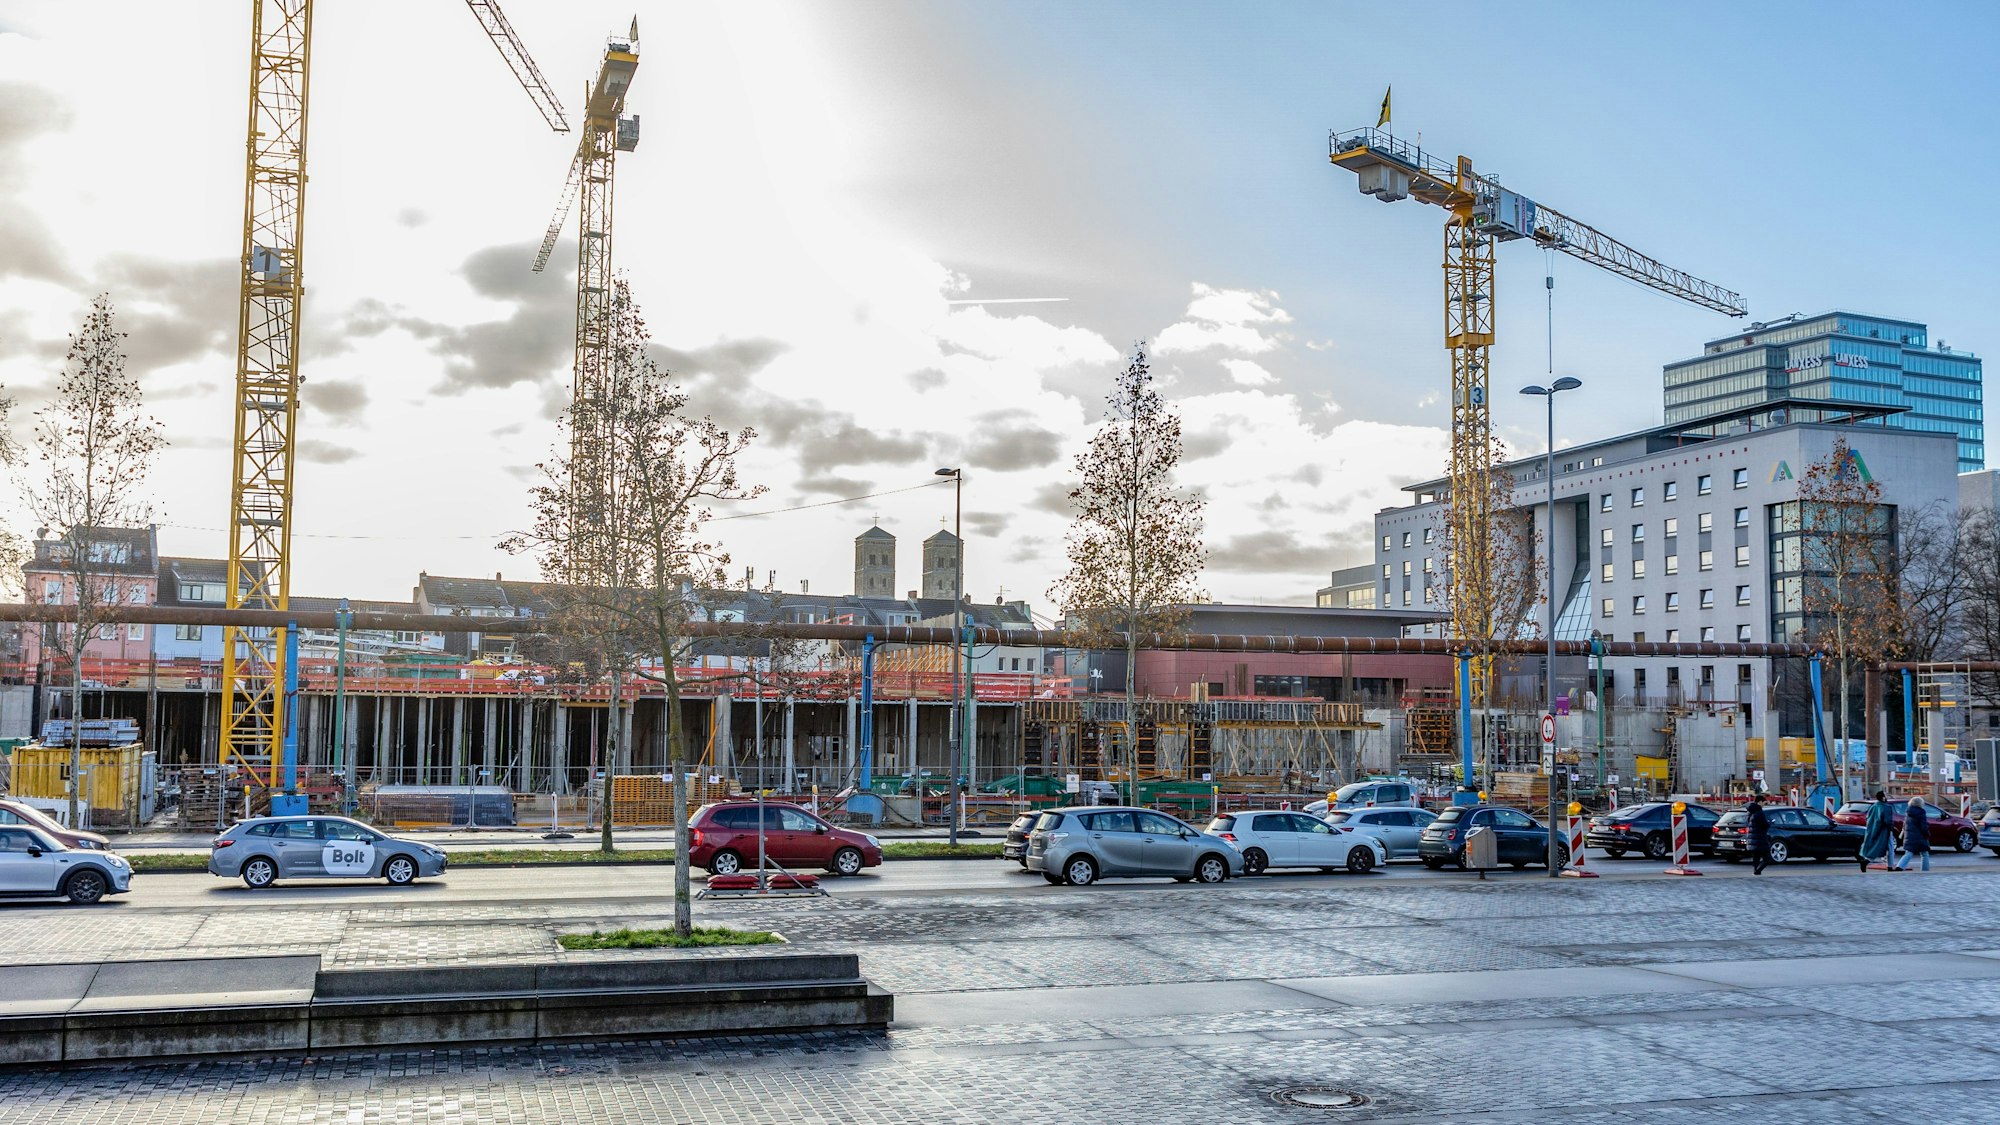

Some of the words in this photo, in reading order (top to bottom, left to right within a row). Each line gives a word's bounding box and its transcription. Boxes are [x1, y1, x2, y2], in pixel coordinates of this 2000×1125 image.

[259, 250, 270, 271] 1
[1785, 354, 1822, 371] LANXESS
[1835, 353, 1868, 369] LANXESS
[1473, 387, 1482, 403] 3
[332, 849, 365, 867] Bolt
